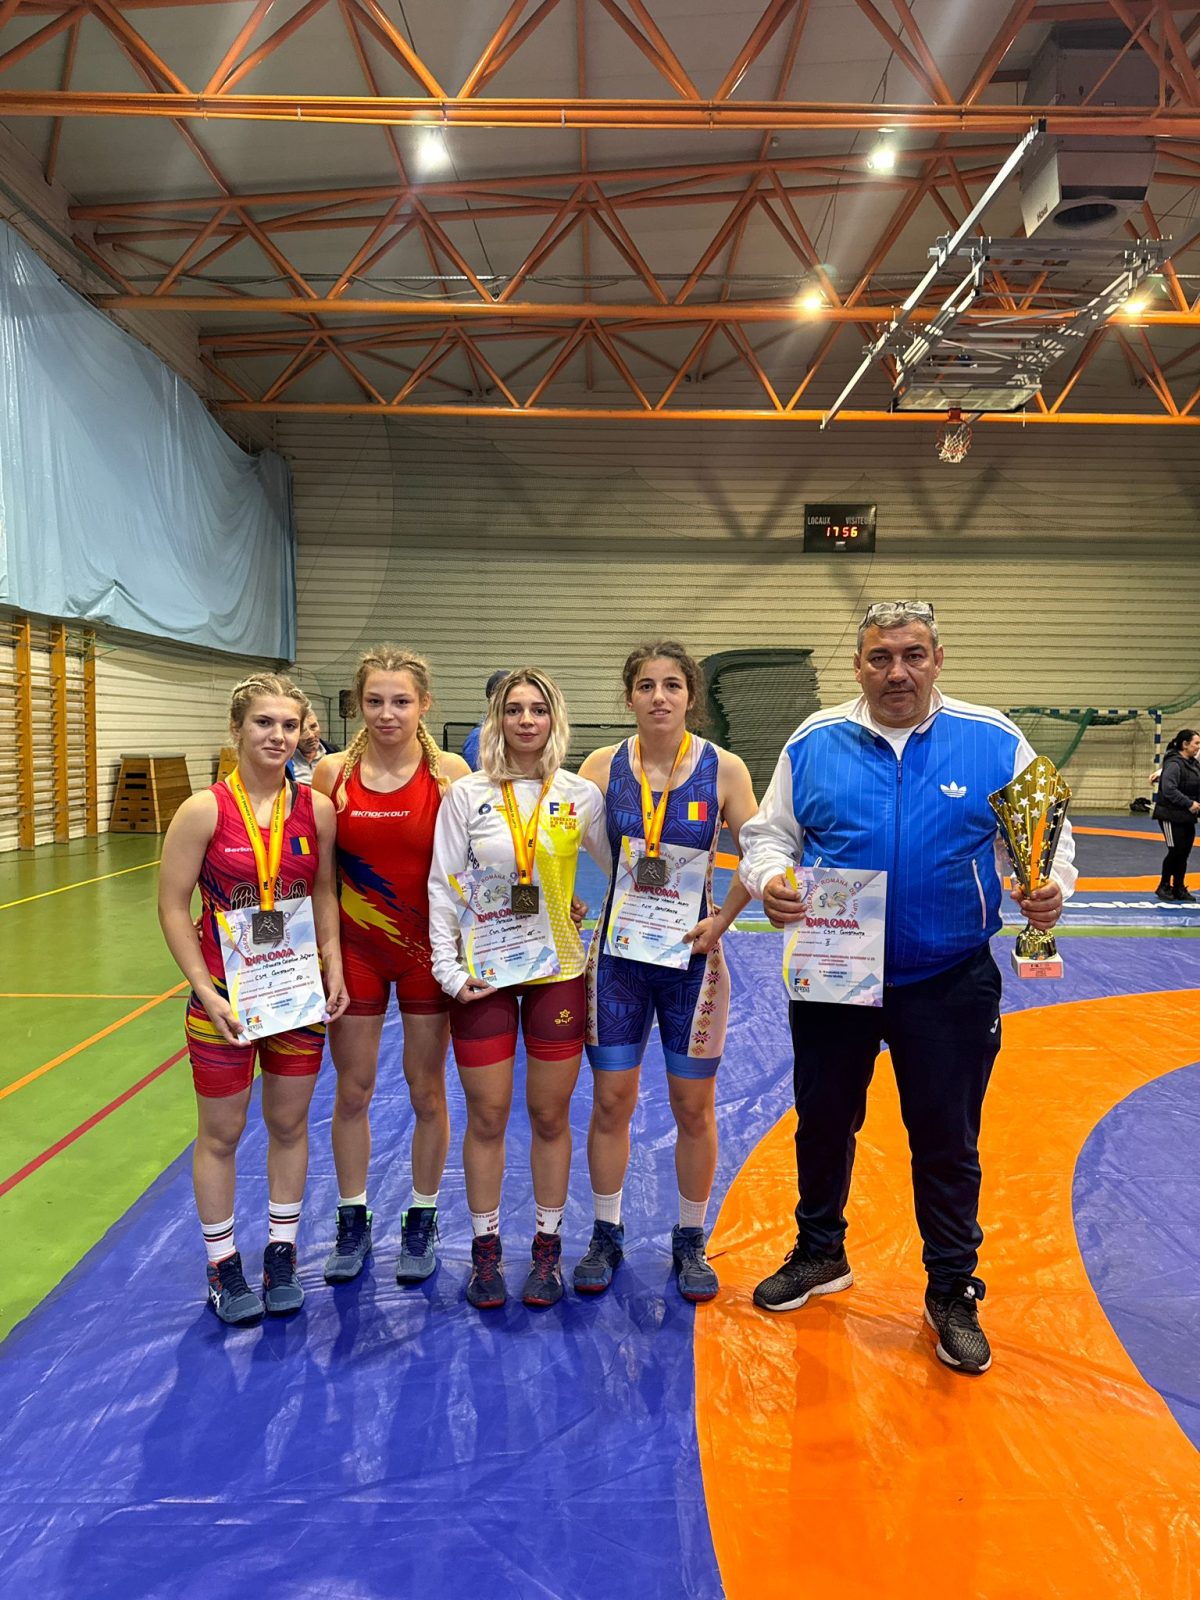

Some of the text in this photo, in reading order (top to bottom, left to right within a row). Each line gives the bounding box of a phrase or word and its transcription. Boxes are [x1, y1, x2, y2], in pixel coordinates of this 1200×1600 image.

[807, 516, 831, 525] LOCAUX
[634, 882, 680, 900] DIPLOMA
[806, 917, 860, 930] DIPLOMA
[245, 948, 295, 966] DIPLOMA
